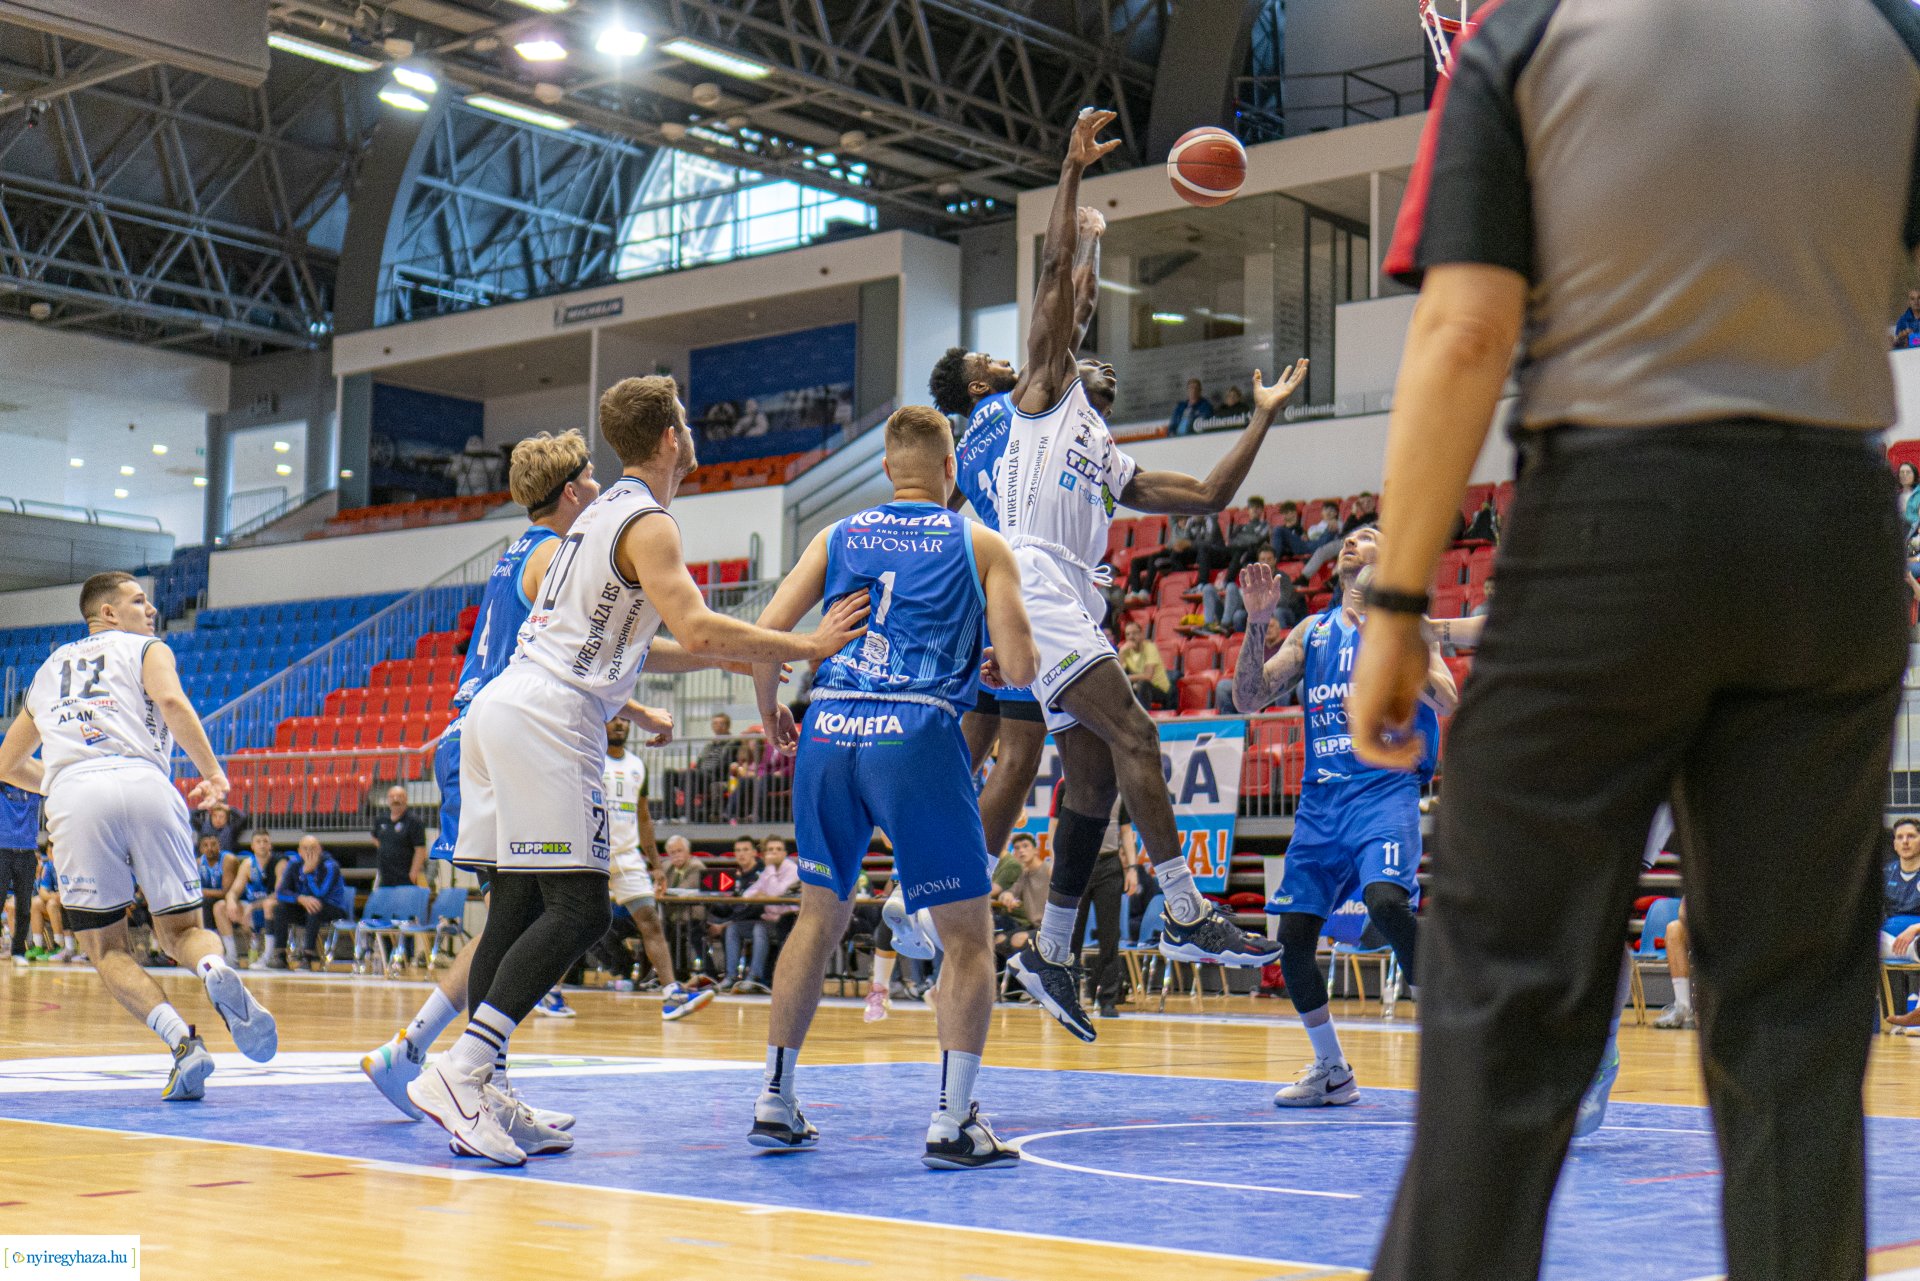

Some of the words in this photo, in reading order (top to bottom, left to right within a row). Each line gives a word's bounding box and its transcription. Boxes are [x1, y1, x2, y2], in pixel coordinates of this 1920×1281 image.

[849, 510, 952, 528] KOMETA
[846, 535, 943, 553] KAPOSVÁR
[601, 582, 621, 602] BS
[875, 570, 896, 625] 1
[629, 598, 645, 617] FM
[613, 614, 635, 661] SUNSHINE
[608, 659, 623, 681] 99.4
[1338, 646, 1354, 672] 11
[59, 654, 110, 699] 12
[1308, 682, 1358, 704] KOME
[814, 710, 904, 736] KOMETA
[593, 806, 610, 846] 2
[1382, 841, 1400, 866] 11
